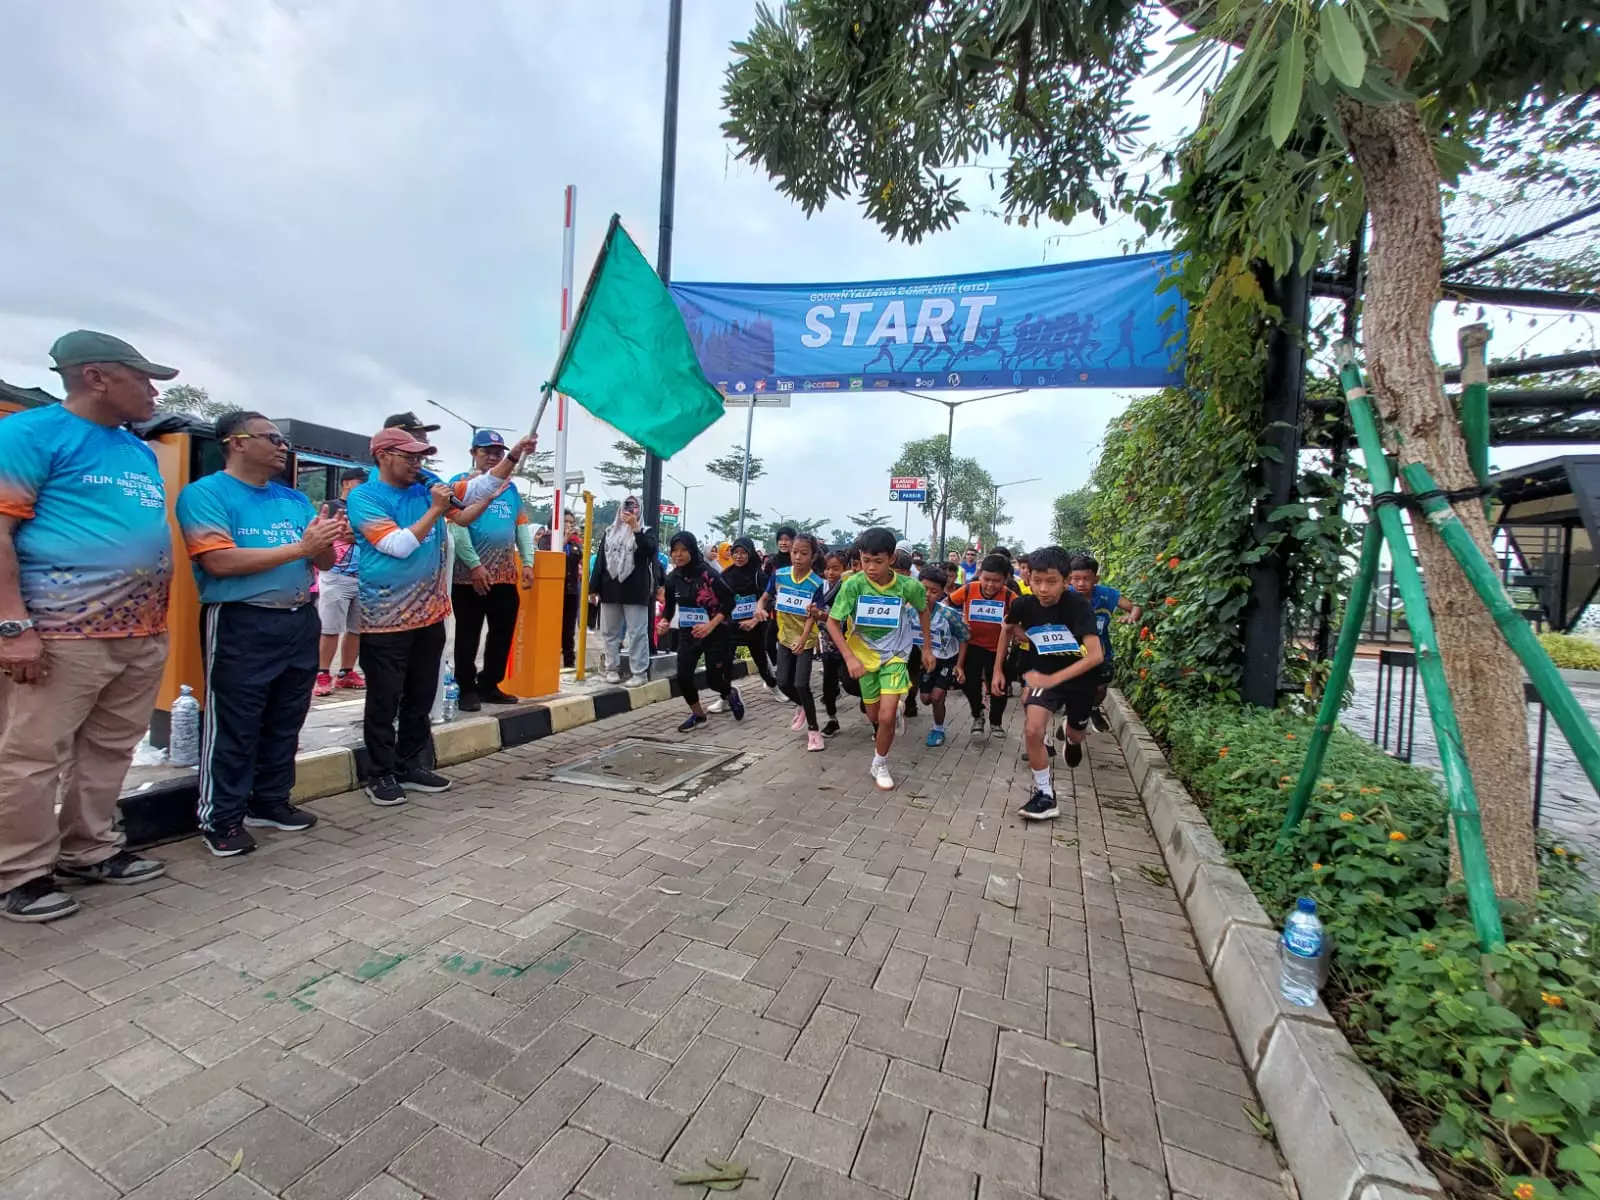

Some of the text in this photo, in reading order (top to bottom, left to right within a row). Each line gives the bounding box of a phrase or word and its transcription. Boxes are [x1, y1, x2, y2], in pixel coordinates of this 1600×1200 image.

[800, 296, 998, 348] START
[82, 474, 113, 485] RUN
[237, 527, 260, 536] RUN
[867, 607, 891, 616] B 04
[1042, 633, 1065, 643] B 02
